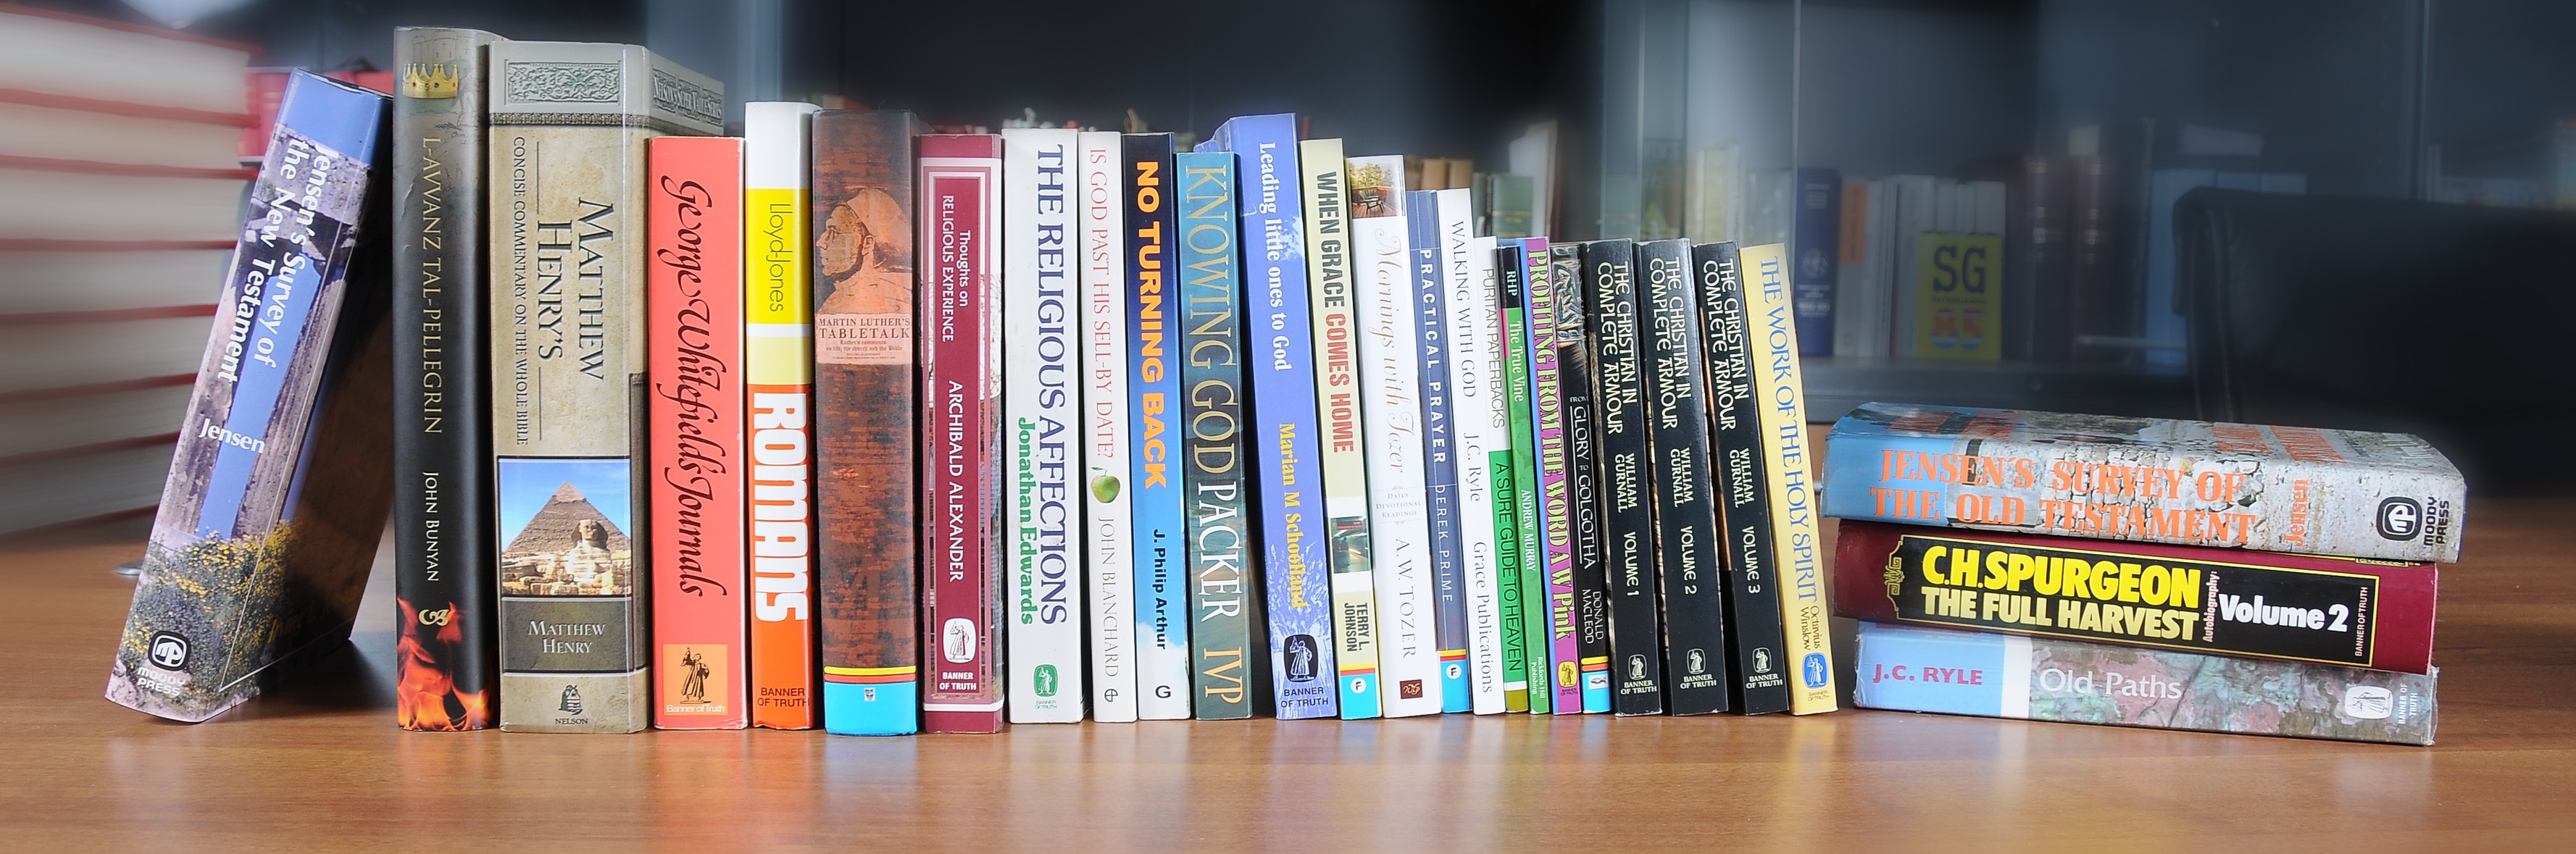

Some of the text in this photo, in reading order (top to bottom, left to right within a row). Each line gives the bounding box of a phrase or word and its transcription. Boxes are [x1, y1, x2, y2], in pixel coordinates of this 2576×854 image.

[218, 140, 308, 382] the New Testament
[254, 144, 338, 367] Jensen's Survey of
[657, 175, 713, 298] George
[763, 203, 793, 312] Lloyd-Jones
[942, 195, 954, 343] RELIGIOUS EXPERIENCE
[956, 230, 971, 307] Thoughts on
[1259, 142, 1292, 371] Leading little ones to God
[1933, 245, 1985, 293] SG
[422, 136, 442, 434] L-AVVANZ TAL-PELLEGRIN
[513, 136, 528, 445] CONCISE COMMENTARY ON THE WHOLE BIBLE
[538, 220, 572, 361] HENRY'S
[578, 196, 614, 381] MATTHEW
[860, 318, 910, 327] LUTHER'S
[1090, 148, 1114, 459] IS GOD PAST HIS SELL-BY DATE?
[1317, 171, 1354, 453] WHEN GRACE COMES HOME
[1451, 220, 1476, 397] WALKING WITH GOD
[1506, 270, 1517, 296] RHP
[819, 327, 910, 338] TABLETALK
[1136, 161, 1167, 489] NO TURNING BACK
[1368, 228, 1414, 473] Mornings with Tozer
[1420, 249, 1446, 463] PRACTICAL PRAYER
[1483, 268, 1505, 429] PURITAN PAPERBACKS
[1509, 320, 1528, 402] The True Vine
[1649, 257, 1678, 430] COMPLETE ARMOUR
[1665, 256, 1692, 399] THE CHRISTIAN IN
[1932, 308, 1983, 351] 85
[1038, 144, 1067, 624] THE RELIGIOUS AFFECTIONS
[1185, 165, 1242, 622] KNOWING GOD PACKER
[1527, 250, 1570, 547] PROFITING FROM THE WORD
[199, 417, 265, 453] Jensen
[1573, 406, 1589, 462] GLORY
[1760, 255, 1817, 603] THE WORK OF THE HOLY SPIRIT
[949, 380, 964, 582] ARCHIBALD ALEXANDER
[1670, 448, 1684, 508] GURNALL
[1680, 447, 1694, 503] WILLIAM
[1870, 487, 2256, 543] THE OLD TESTAMENT
[1880, 449, 2246, 503] JENSEN'S SURVEY OF
[2283, 479, 2309, 548] Jensen
[422, 471, 439, 582] JOHN BUNYAN
[664, 467, 728, 598] Journals
[1018, 416, 1038, 625] Jonathan Edwards
[1435, 484, 1453, 602] DEREK PRIME
[1522, 489, 1537, 572] ANDREW MURRAY
[1578, 475, 1597, 570] GOLGOTHA
[1680, 525, 1698, 595] VOLUME 2
[2423, 496, 2437, 546] MOODY
[2435, 500, 2449, 544] PRESS
[1098, 516, 1119, 677] JOHN BLANCHARD
[1496, 462, 1522, 671] A SURE GUIDE TO HEAVEN
[2203, 570, 2220, 642] Autobiography:
[528, 619, 606, 637] MATTHEW
[543, 638, 592, 654] HENRY
[1473, 542, 1493, 693] Grace Publications
[1582, 588, 1594, 645] MACLEOD
[1593, 590, 1605, 641] DONALD
[1800, 606, 1811, 651] Winslow
[1810, 606, 1821, 649] Octavius
[1921, 587, 2199, 641] THE FULL HARVEST
[2219, 593, 2349, 632] Volume 2
[137, 667, 186, 696] MOODY PRESS
[757, 698, 809, 708] OF TRUTH
[761, 687, 805, 697] BANNER
[1203, 646, 1243, 704] IVP
[1923, 667, 1983, 685] RYLE
[2040, 668, 2183, 700] Old Paths
[2398, 683, 2408, 724] BANNER OF
[2409, 693, 2418, 716] TRUTH
